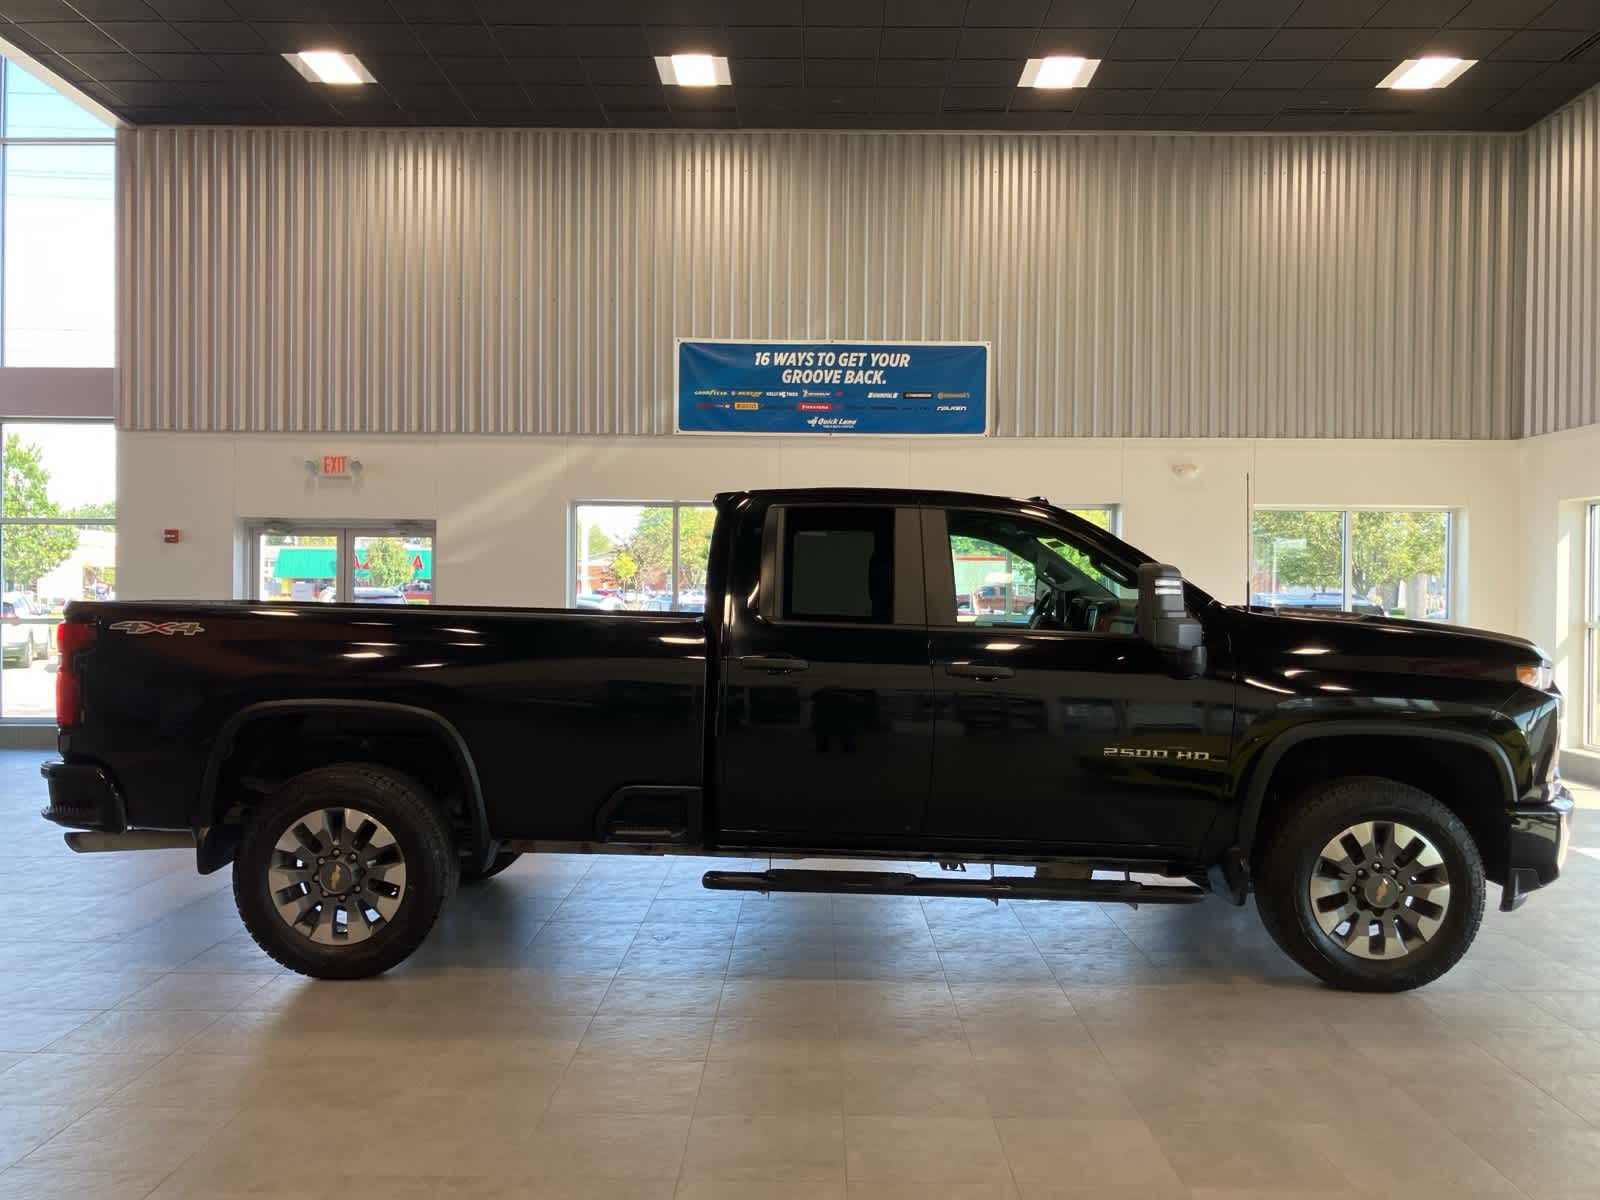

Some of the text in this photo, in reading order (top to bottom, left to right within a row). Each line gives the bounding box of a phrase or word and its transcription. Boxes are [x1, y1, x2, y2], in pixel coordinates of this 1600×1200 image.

[754, 352, 911, 368] 16 WAYS TO GET YOUR
[781, 369, 887, 385] GROOVE BACK.
[818, 417, 839, 425] Quick
[323, 455, 348, 474] EXIT
[1103, 747, 1210, 760] 2500 HD
